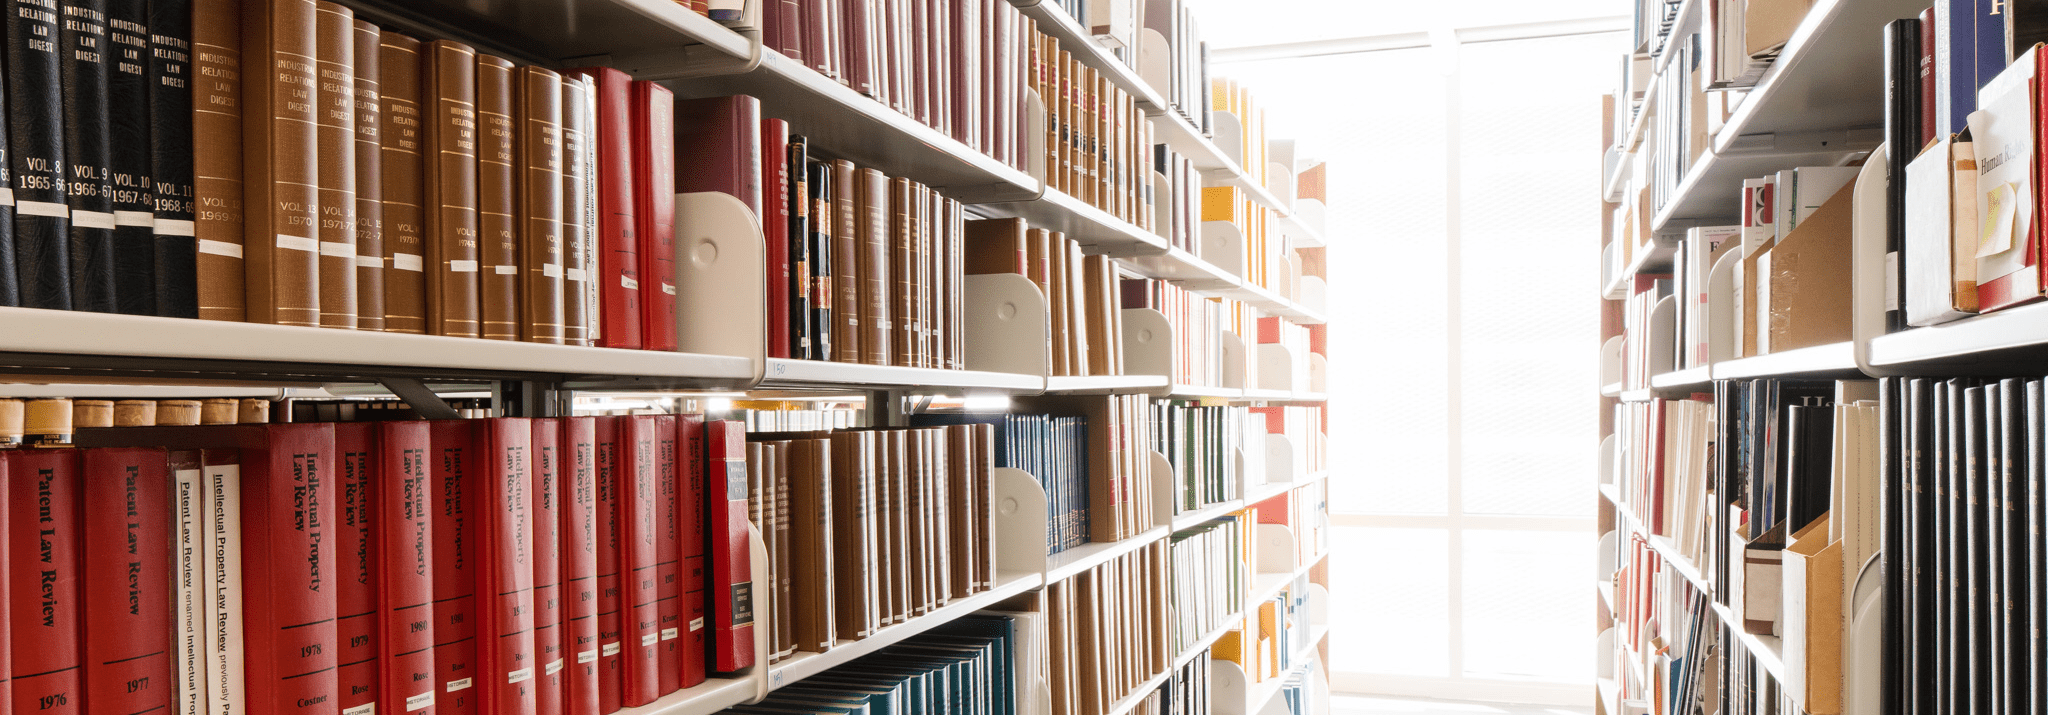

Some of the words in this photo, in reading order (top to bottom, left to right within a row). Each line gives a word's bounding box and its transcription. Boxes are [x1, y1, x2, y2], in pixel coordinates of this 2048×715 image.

[18, 6, 57, 25] RELATIONS
[64, 5, 105, 23] INDUSTRIAL
[33, 24, 48, 37] LAW
[66, 19, 105, 36] RELATIONS
[110, 18, 147, 35] INDUSTRIAL
[28, 38, 54, 53] DIGEST
[80, 36, 96, 49] LAW
[112, 32, 147, 49] RELATIONS
[75, 50, 101, 64] DIGEST
[124, 48, 138, 61] LAW
[119, 61, 142, 76] DIGEST
[166, 63, 180, 74] LAW
[161, 75, 185, 89] DIGEST
[215, 81, 231, 93] LAW
[210, 94, 236, 108] DIGEST
[292, 88, 308, 99] LAW
[334, 97, 348, 107] LAW
[287, 101, 312, 114] DIGEST
[330, 109, 351, 121] DIGEST
[362, 114, 375, 124] LAW
[26, 156, 53, 173] VOL.
[55, 160, 61, 174] 8
[74, 164, 100, 180] VOL.
[102, 167, 108, 180] 9
[1981, 152, 2004, 176] Human
[20, 175, 66, 192] 1965-66
[114, 172, 138, 188] VOL.
[140, 175, 150, 188] 10
[68, 182, 113, 199] 1966-67
[112, 189, 153, 206] 1967-68
[157, 182, 181, 197] VOL.
[183, 184, 193, 198] 11
[154, 198, 195, 214] 1968-69
[307, 203, 317, 214] 13
[288, 215, 313, 227] 1970
[773, 362, 785, 376] 150
[293, 453, 306, 482] Law
[345, 451, 357, 480] Law
[403, 448, 413, 475] Law
[444, 448, 453, 473] Law
[507, 446, 515, 471] Law
[543, 446, 551, 471] Law
[126, 465, 139, 518] Patent
[307, 452, 320, 529] Intellectual
[358, 451, 368, 523] Intellectual
[415, 448, 424, 518] Intellectual
[543, 472, 551, 511] Review
[577, 468, 586, 506] Review
[600, 467, 608, 502] Review
[39, 467, 54, 524] Patent
[182, 482, 191, 518] Patent
[404, 478, 415, 521] Review
[444, 477, 454, 517] Review
[507, 474, 515, 513] Review
[215, 474, 225, 534] Intellectual
[294, 485, 307, 532] Review
[345, 482, 358, 527] Review
[127, 522, 140, 555] Law
[183, 521, 192, 544] Law
[516, 513, 524, 564] Property
[40, 527, 56, 564] Law
[415, 521, 426, 577] Property
[216, 537, 227, 584] Property
[308, 531, 322, 593] Property
[357, 527, 368, 585] Property
[184, 547, 193, 588] Review
[128, 561, 141, 615] Review
[41, 568, 58, 628] Review
[218, 587, 227, 609] Law
[185, 590, 194, 633] renamed
[219, 612, 228, 652] Review
[410, 620, 428, 633] 1980
[350, 634, 369, 648] 1979
[300, 643, 322, 658] 1978
[186, 635, 196, 691] Intellectual
[126, 676, 149, 693] 1977
[219, 654, 229, 702] previously
[413, 672, 429, 682] Rose
[352, 685, 369, 695] Rose
[39, 692, 67, 710] 1976
[297, 695, 328, 708] Costner
[457, 697, 464, 708] 13
